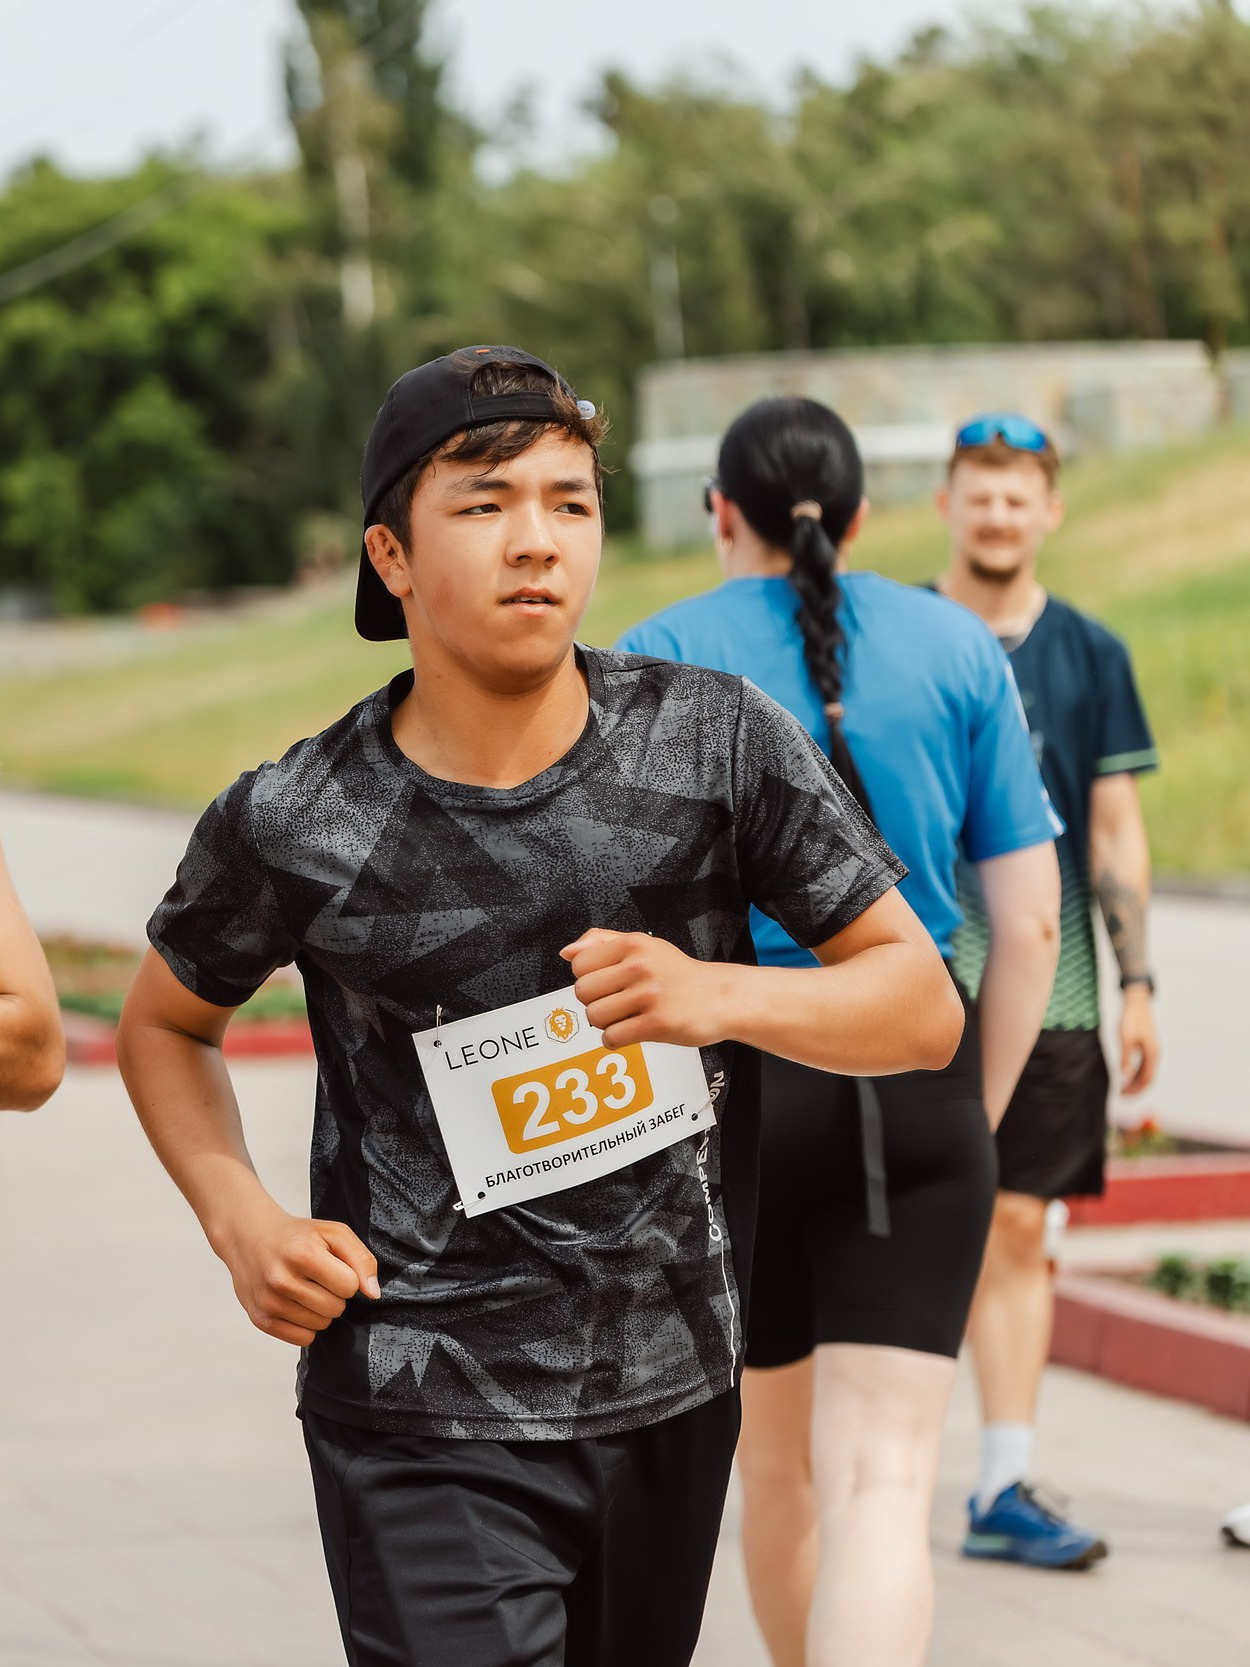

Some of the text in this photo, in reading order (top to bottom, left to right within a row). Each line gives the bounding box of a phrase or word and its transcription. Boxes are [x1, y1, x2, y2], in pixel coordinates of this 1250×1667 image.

[445, 1026, 540, 1071] LEONE
[511, 1053, 637, 1142] 233
[485, 1103, 686, 1188] БЛАГОТВОРИТЕЛЬНЫЙ ЗАБЕГ
